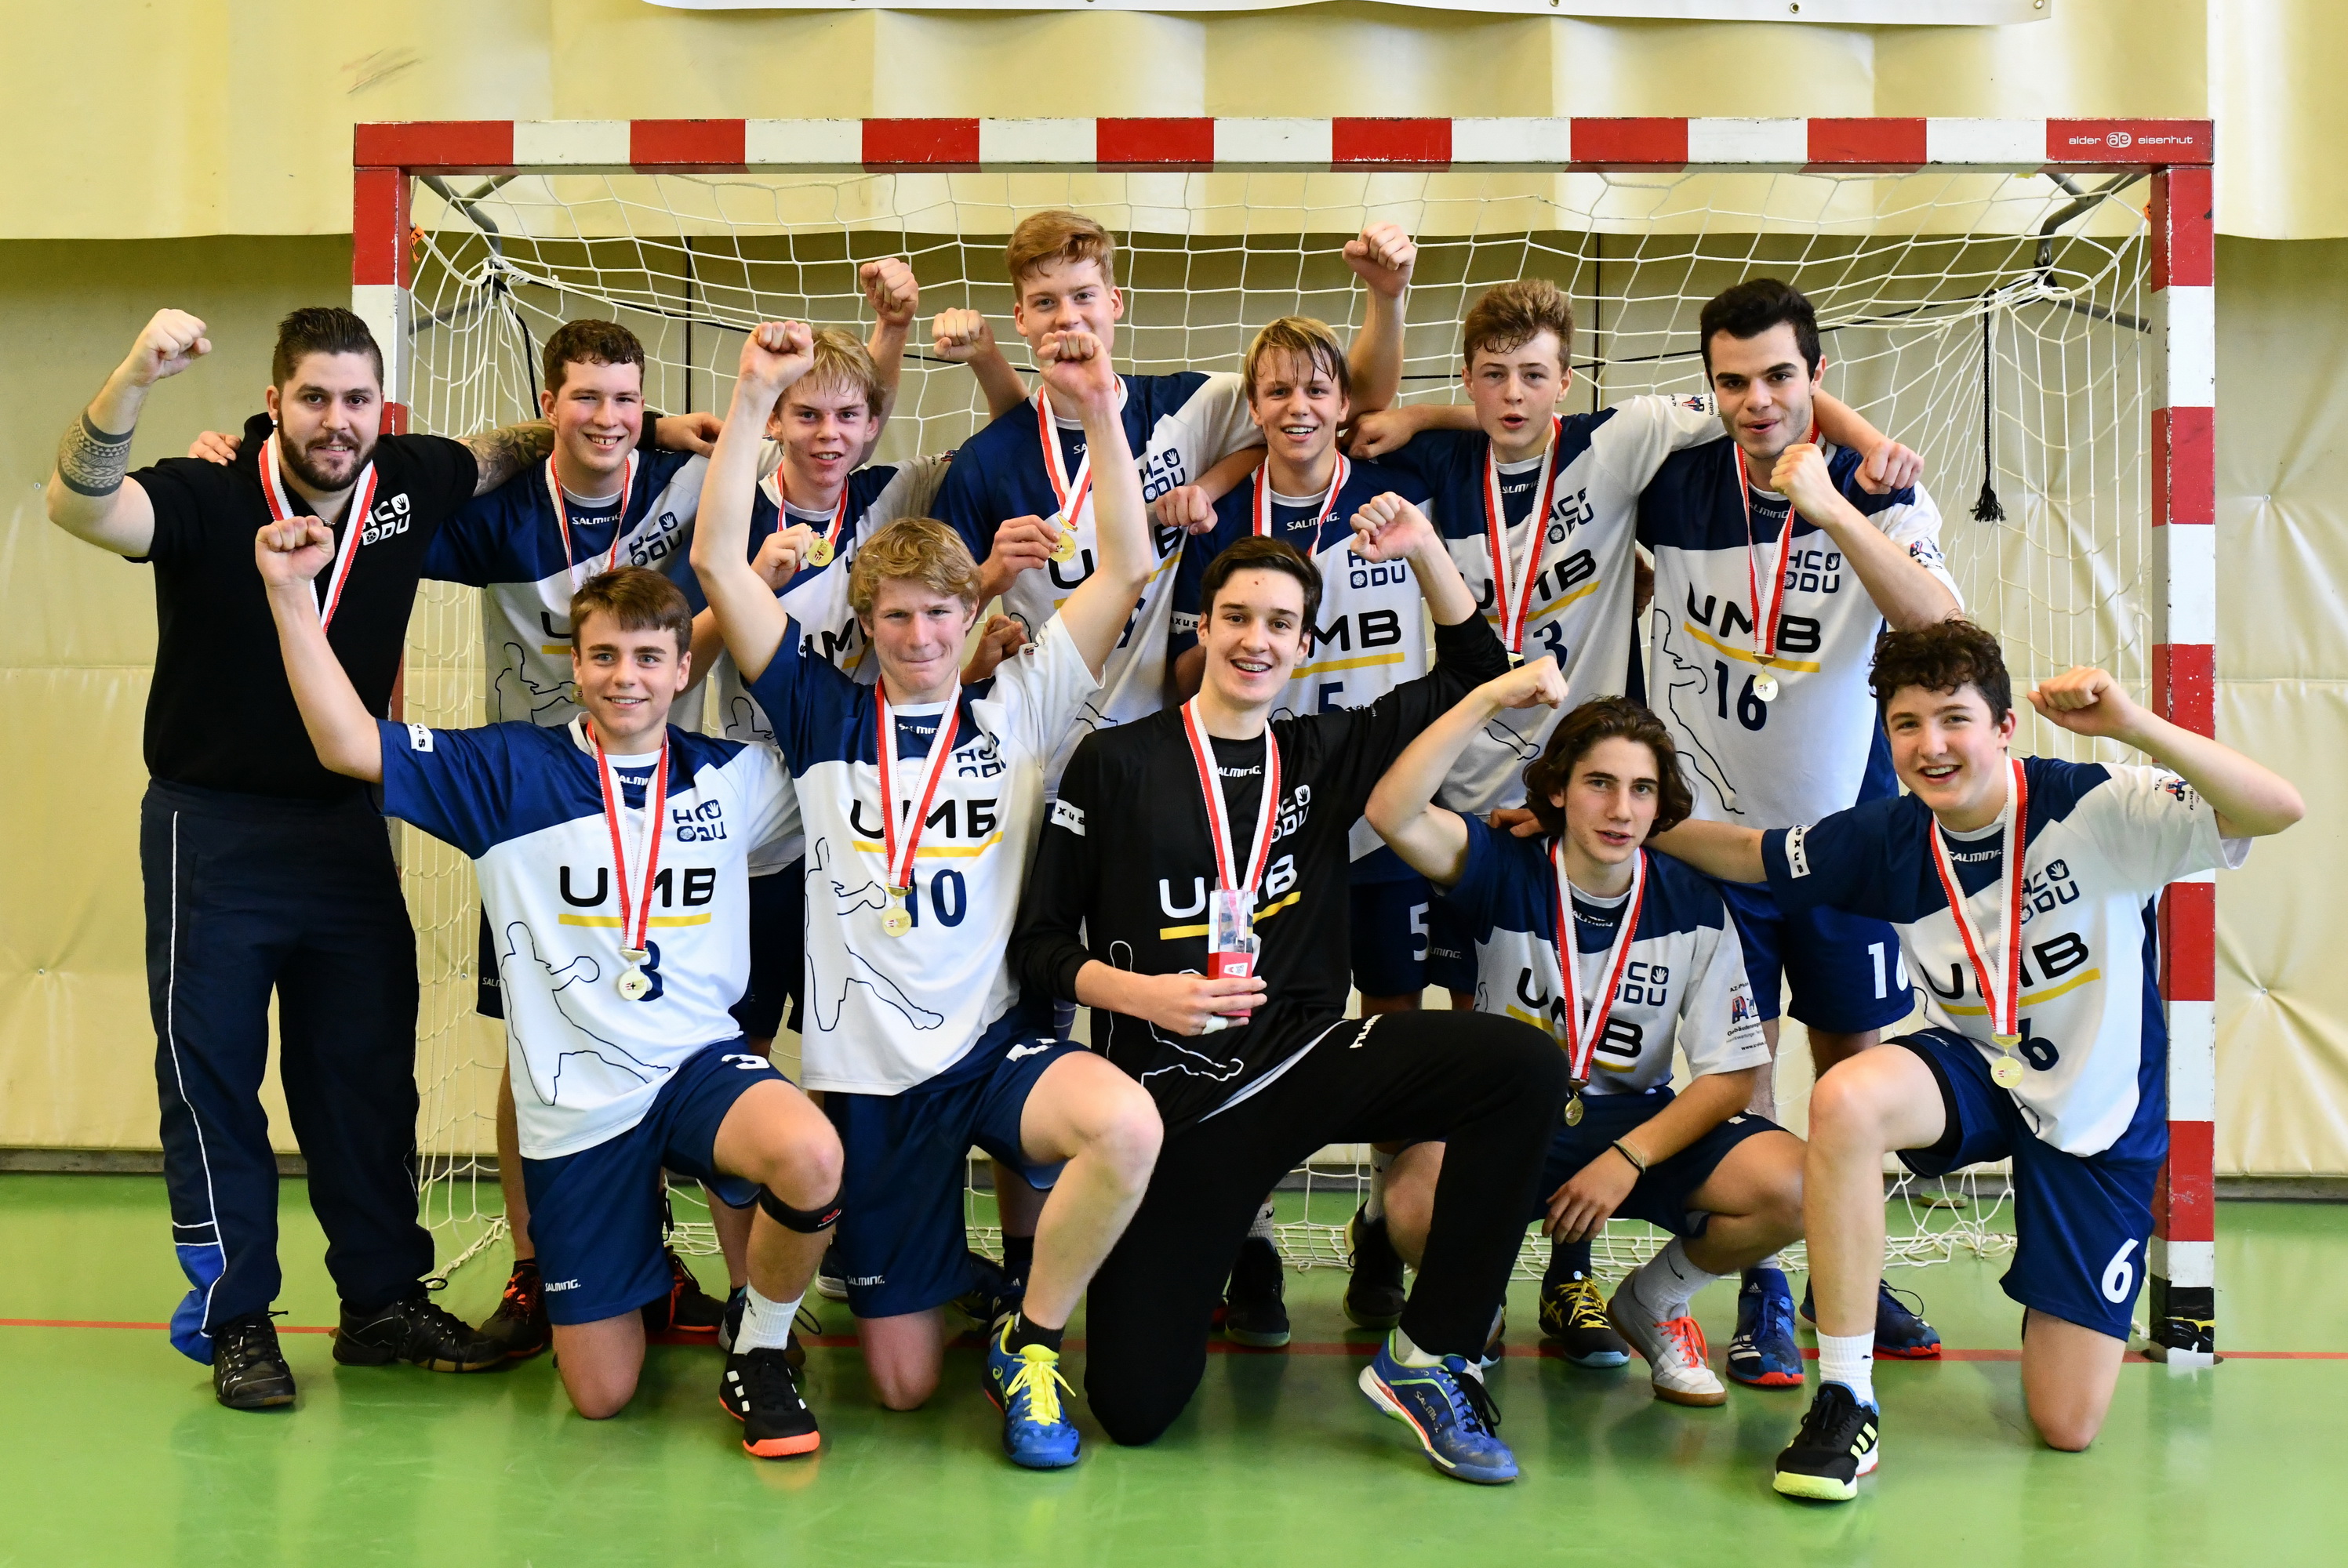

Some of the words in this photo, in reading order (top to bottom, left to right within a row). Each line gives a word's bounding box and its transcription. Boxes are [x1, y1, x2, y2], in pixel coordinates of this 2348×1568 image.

[2069, 135, 2102, 145] alder
[2138, 135, 2194, 145] eisenhut
[1308, 609, 1401, 659] MB
[1714, 659, 1767, 731] 16
[1217, 765, 1262, 778] ALMING.
[905, 868, 967, 927] 10
[1158, 854, 1298, 919] UB
[1409, 901, 1430, 961] 5
[2018, 1018, 2059, 1072] 6
[2101, 1238, 2139, 1303] 6
